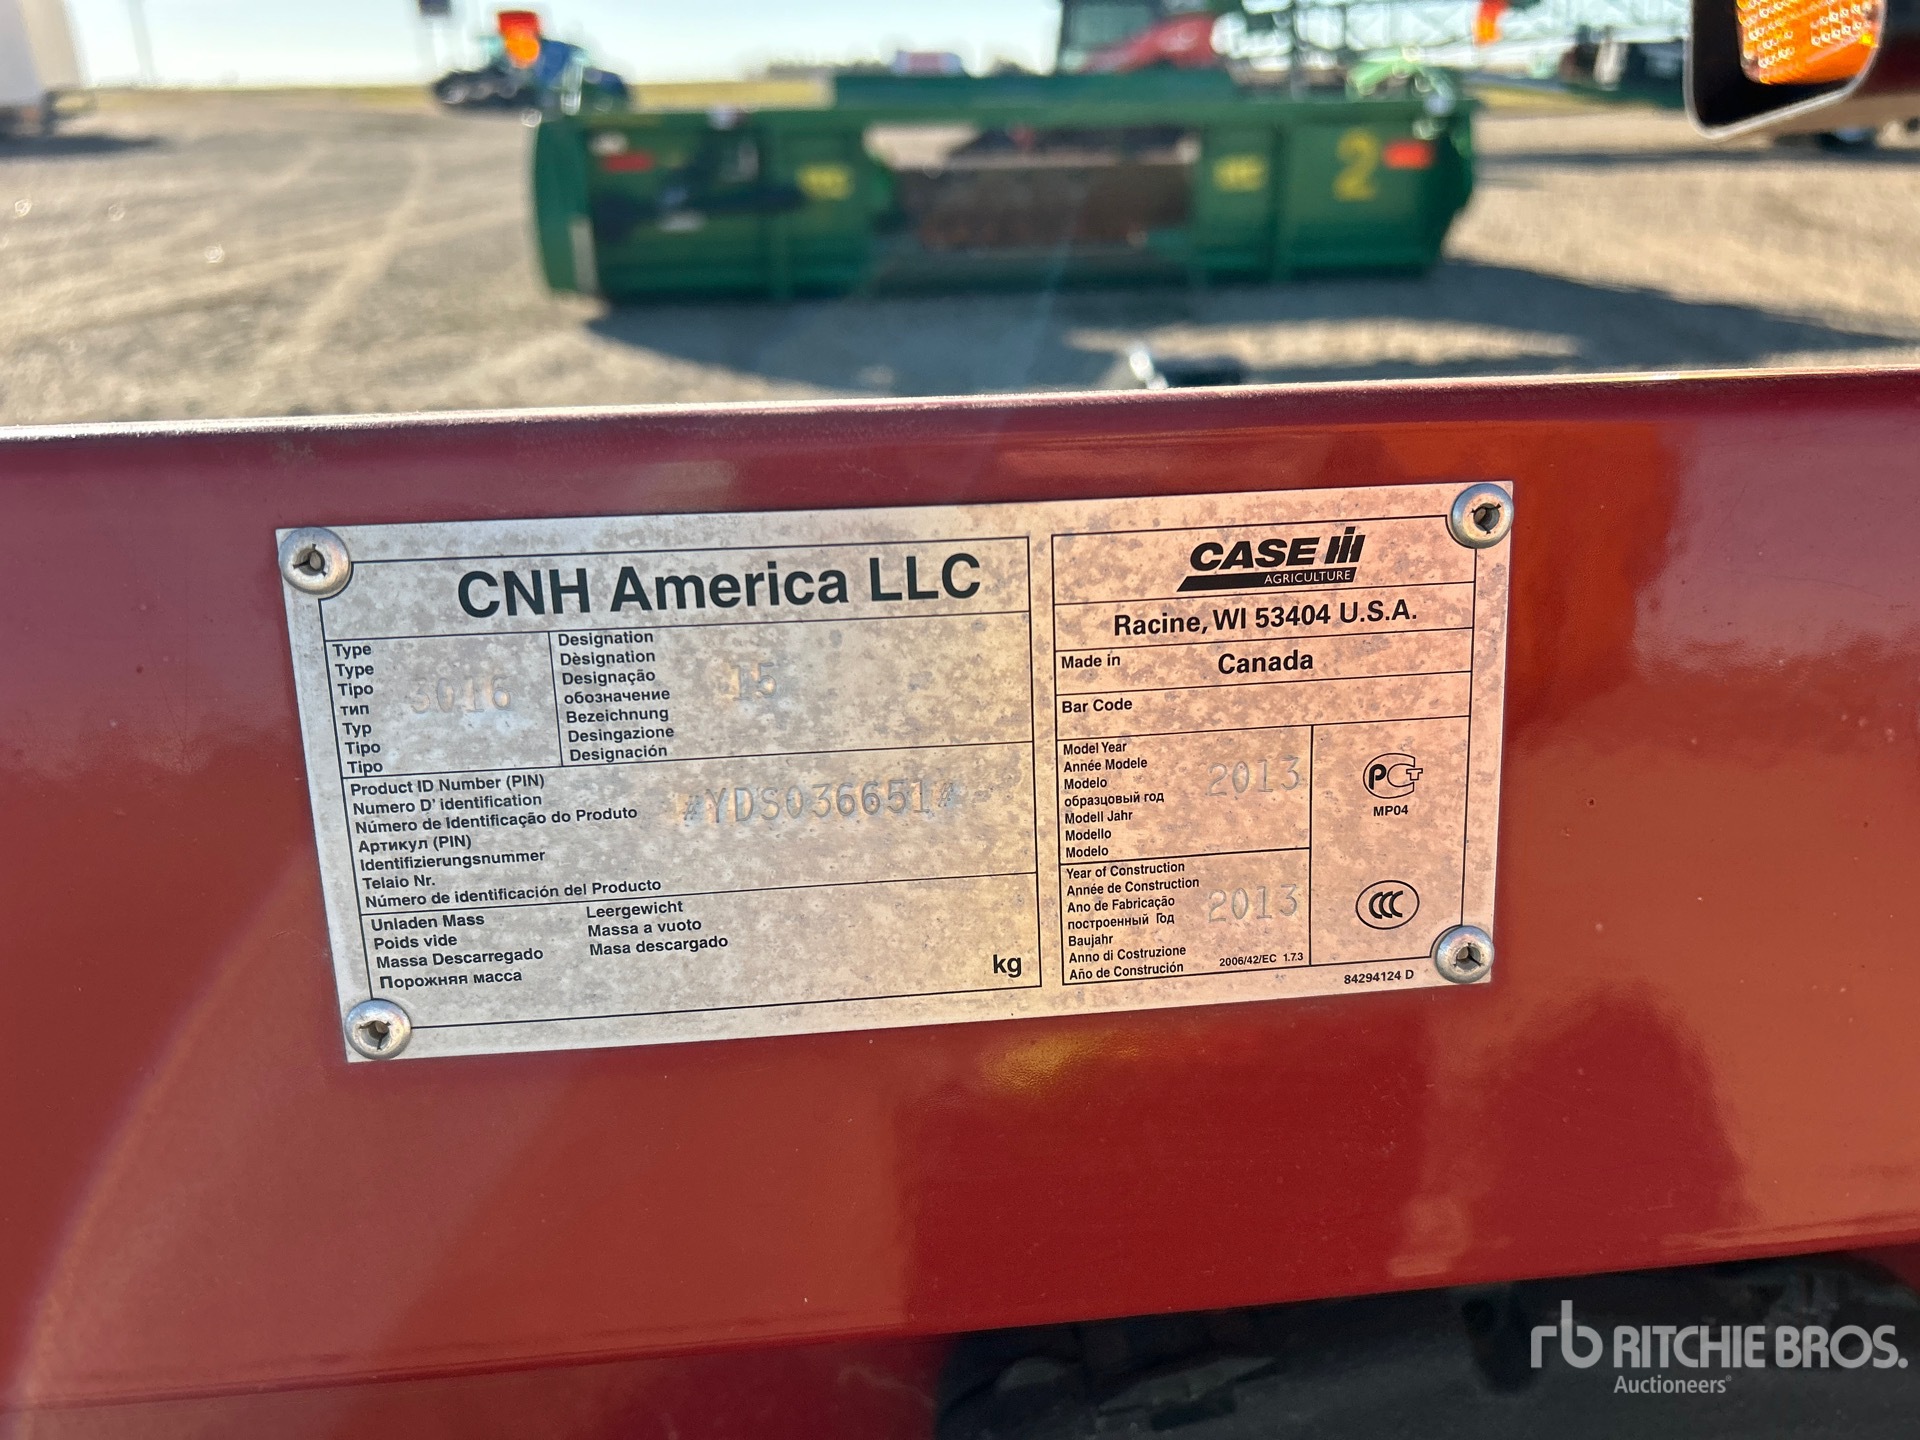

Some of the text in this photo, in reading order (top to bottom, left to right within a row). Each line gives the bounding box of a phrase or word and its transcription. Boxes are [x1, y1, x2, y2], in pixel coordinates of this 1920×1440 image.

[1333, 127, 1379, 202] 2
[1190, 536, 1321, 572] CASE
[457, 553, 981, 616] CNH America LLC
[1264, 569, 1351, 586] AGRICULTURE
[1114, 599, 1417, 637] Racine, WI 53404 U.S.A.
[558, 631, 654, 649] Designation
[333, 644, 372, 660] Type
[1061, 654, 1121, 670] Made in
[1218, 650, 1314, 675] Canada
[335, 664, 374, 680] Type
[562, 669, 656, 688] Designação
[338, 683, 374, 699] Tipo
[564, 688, 670, 706] обозначение
[340, 704, 370, 716] тип
[1062, 698, 1133, 714] Bar Code
[566, 706, 669, 726] Bezeichnung
[343, 723, 372, 739] Typ
[568, 725, 675, 744] Desingazione
[345, 742, 381, 758] Tipo
[570, 745, 668, 763] Designación
[1063, 741, 1127, 755] Model Year
[347, 761, 383, 777] Tipo
[1064, 758, 1148, 773] Année Modele
[1064, 778, 1107, 790] Modelo
[1205, 755, 1300, 797] 2013
[351, 774, 545, 797] Product ID Number (PIN)
[353, 800, 416, 815] Numero
[440, 793, 542, 811] identification
[1064, 792, 1165, 809] образцовый год
[1065, 810, 1133, 824] Modell Jahr
[1373, 805, 1408, 816] MP04
[355, 807, 638, 834] Número de Identificação do Produto
[1065, 829, 1111, 841] Modello
[359, 835, 472, 855] Артикул (PIN)
[1066, 846, 1109, 858] Modelo
[361, 851, 546, 871] Identifizierungsnummer
[1067, 863, 1185, 879] Year of Construction
[362, 874, 436, 890] Telaio Nr.
[1067, 879, 1200, 896] Année de Construction
[365, 879, 661, 908] Número de identificación del Producto
[586, 900, 684, 921] Leergewicht
[1067, 897, 1175, 913] Ano de Fabricação
[1208, 883, 1299, 923] 2013
[371, 914, 485, 932] Unladen Mass
[588, 919, 702, 938] Massa a vuoto
[1068, 913, 1175, 930] построенный Год
[374, 934, 458, 951] Poids vide
[589, 936, 728, 956] Masa descargado
[1068, 934, 1113, 948] Baujahr
[377, 948, 543, 969] Massa Descarregado
[1069, 946, 1186, 964] Anno di Costruzione
[1219, 953, 1304, 967] 2006/42/EC 1.7.3
[993, 955, 1022, 978] kg
[1070, 962, 1183, 980] Año de Construción
[380, 970, 522, 991] Порожняя масса
[1344, 970, 1414, 984] 84294124 D
